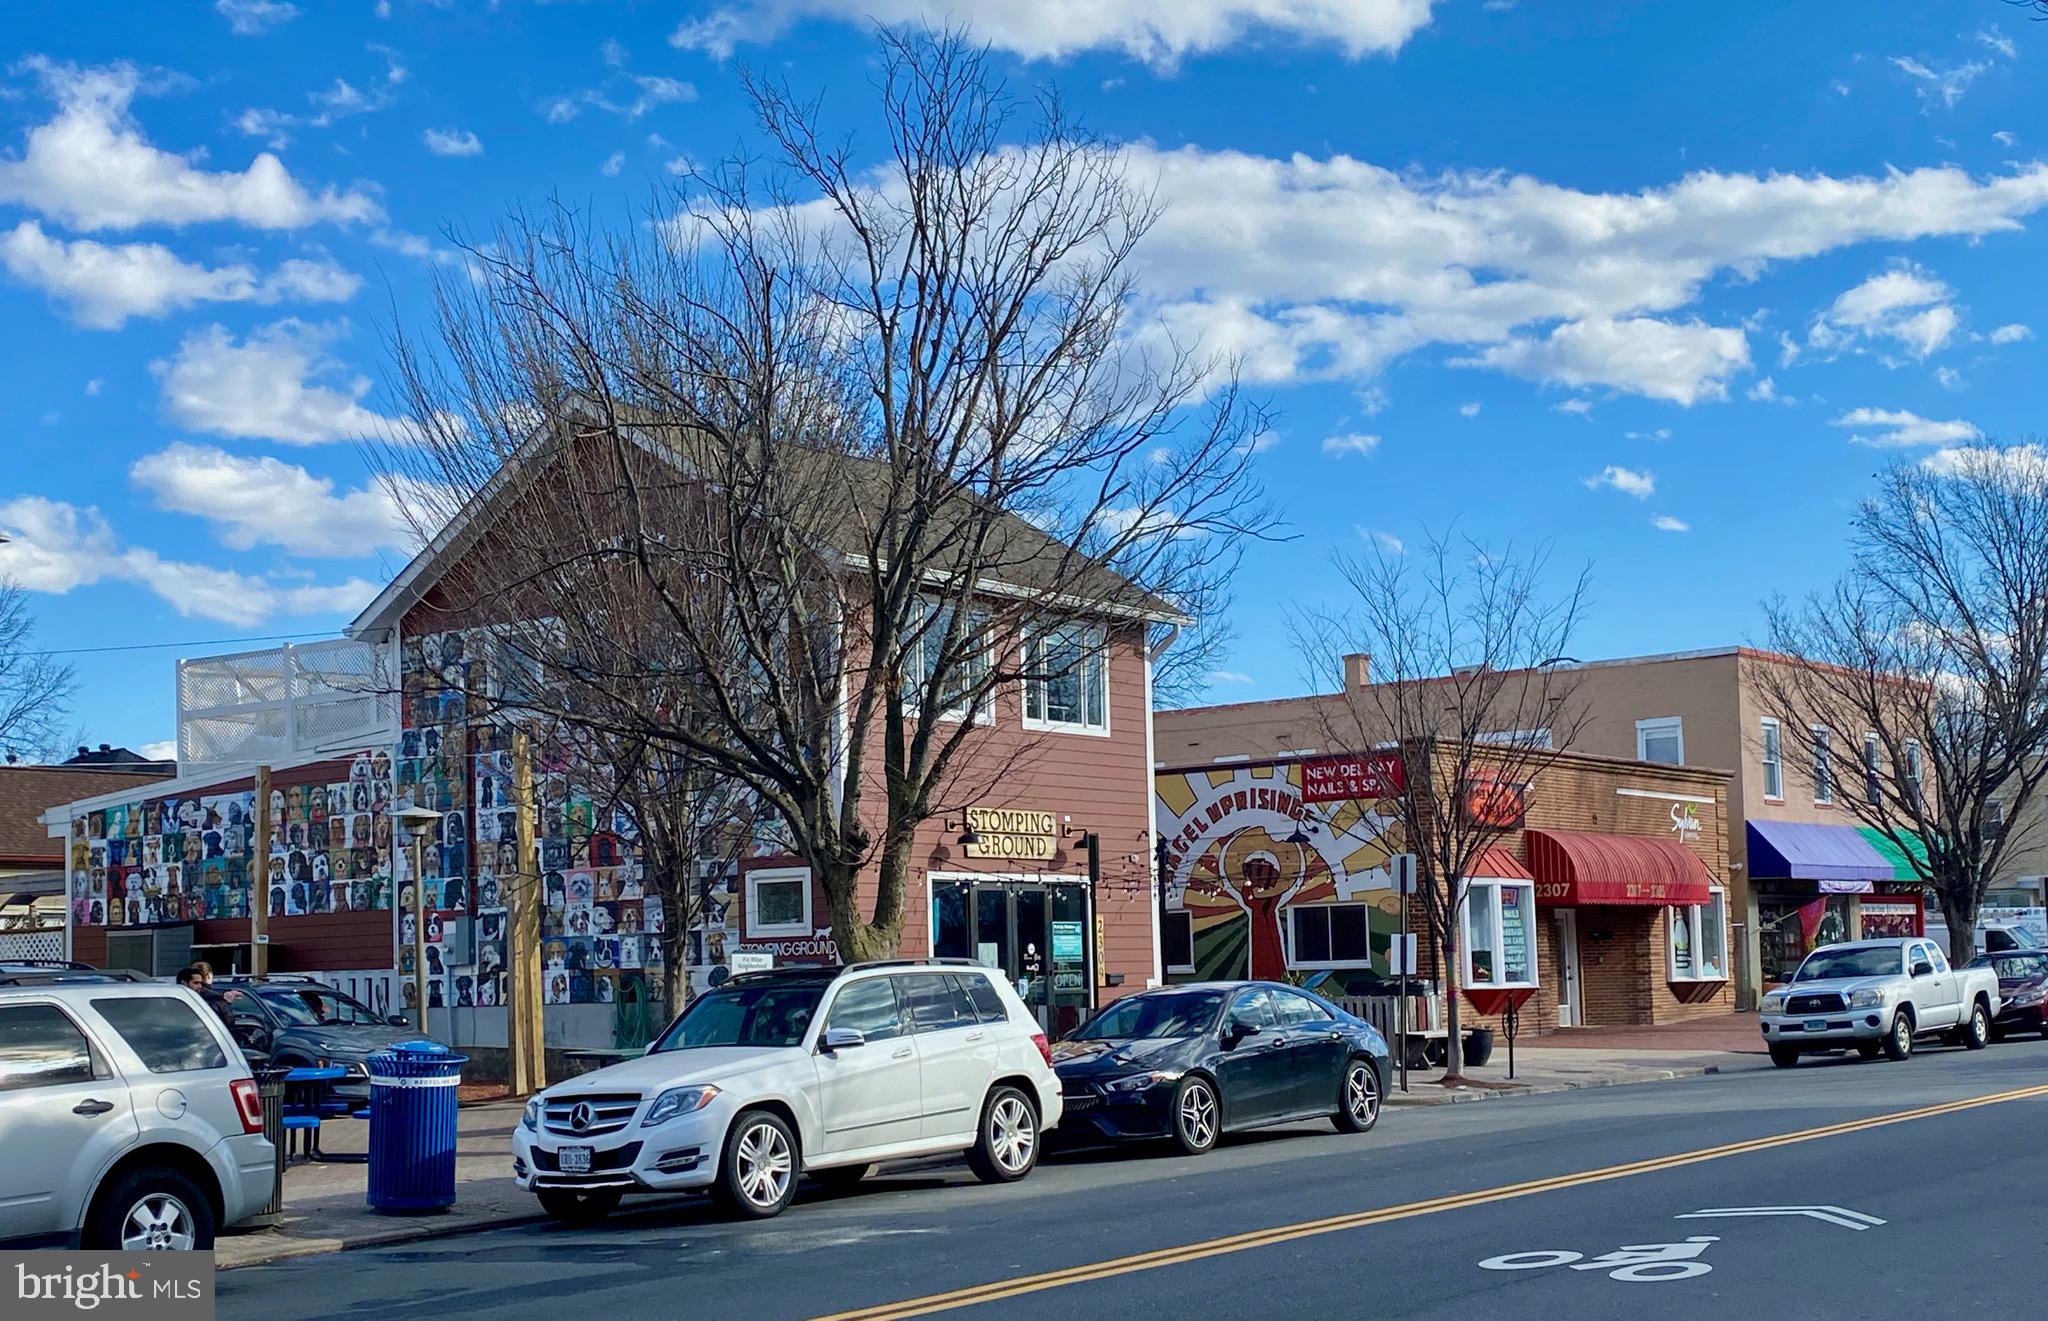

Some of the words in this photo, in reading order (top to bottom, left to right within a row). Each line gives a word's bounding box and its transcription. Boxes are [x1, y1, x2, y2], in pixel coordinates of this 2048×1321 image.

[1306, 764, 1336, 780] NEW
[1340, 763, 1363, 777] DEL
[1307, 780, 1344, 796] NAILS
[1349, 779, 1358, 793] &
[1205, 787, 1304, 822] UPRISING
[969, 809, 1053, 834] STOMPING
[977, 835, 1047, 857] GROUND
[1536, 883, 1570, 897] 2307
[1096, 920, 1105, 977] 2309
[1055, 973, 1082, 987] OPEN
